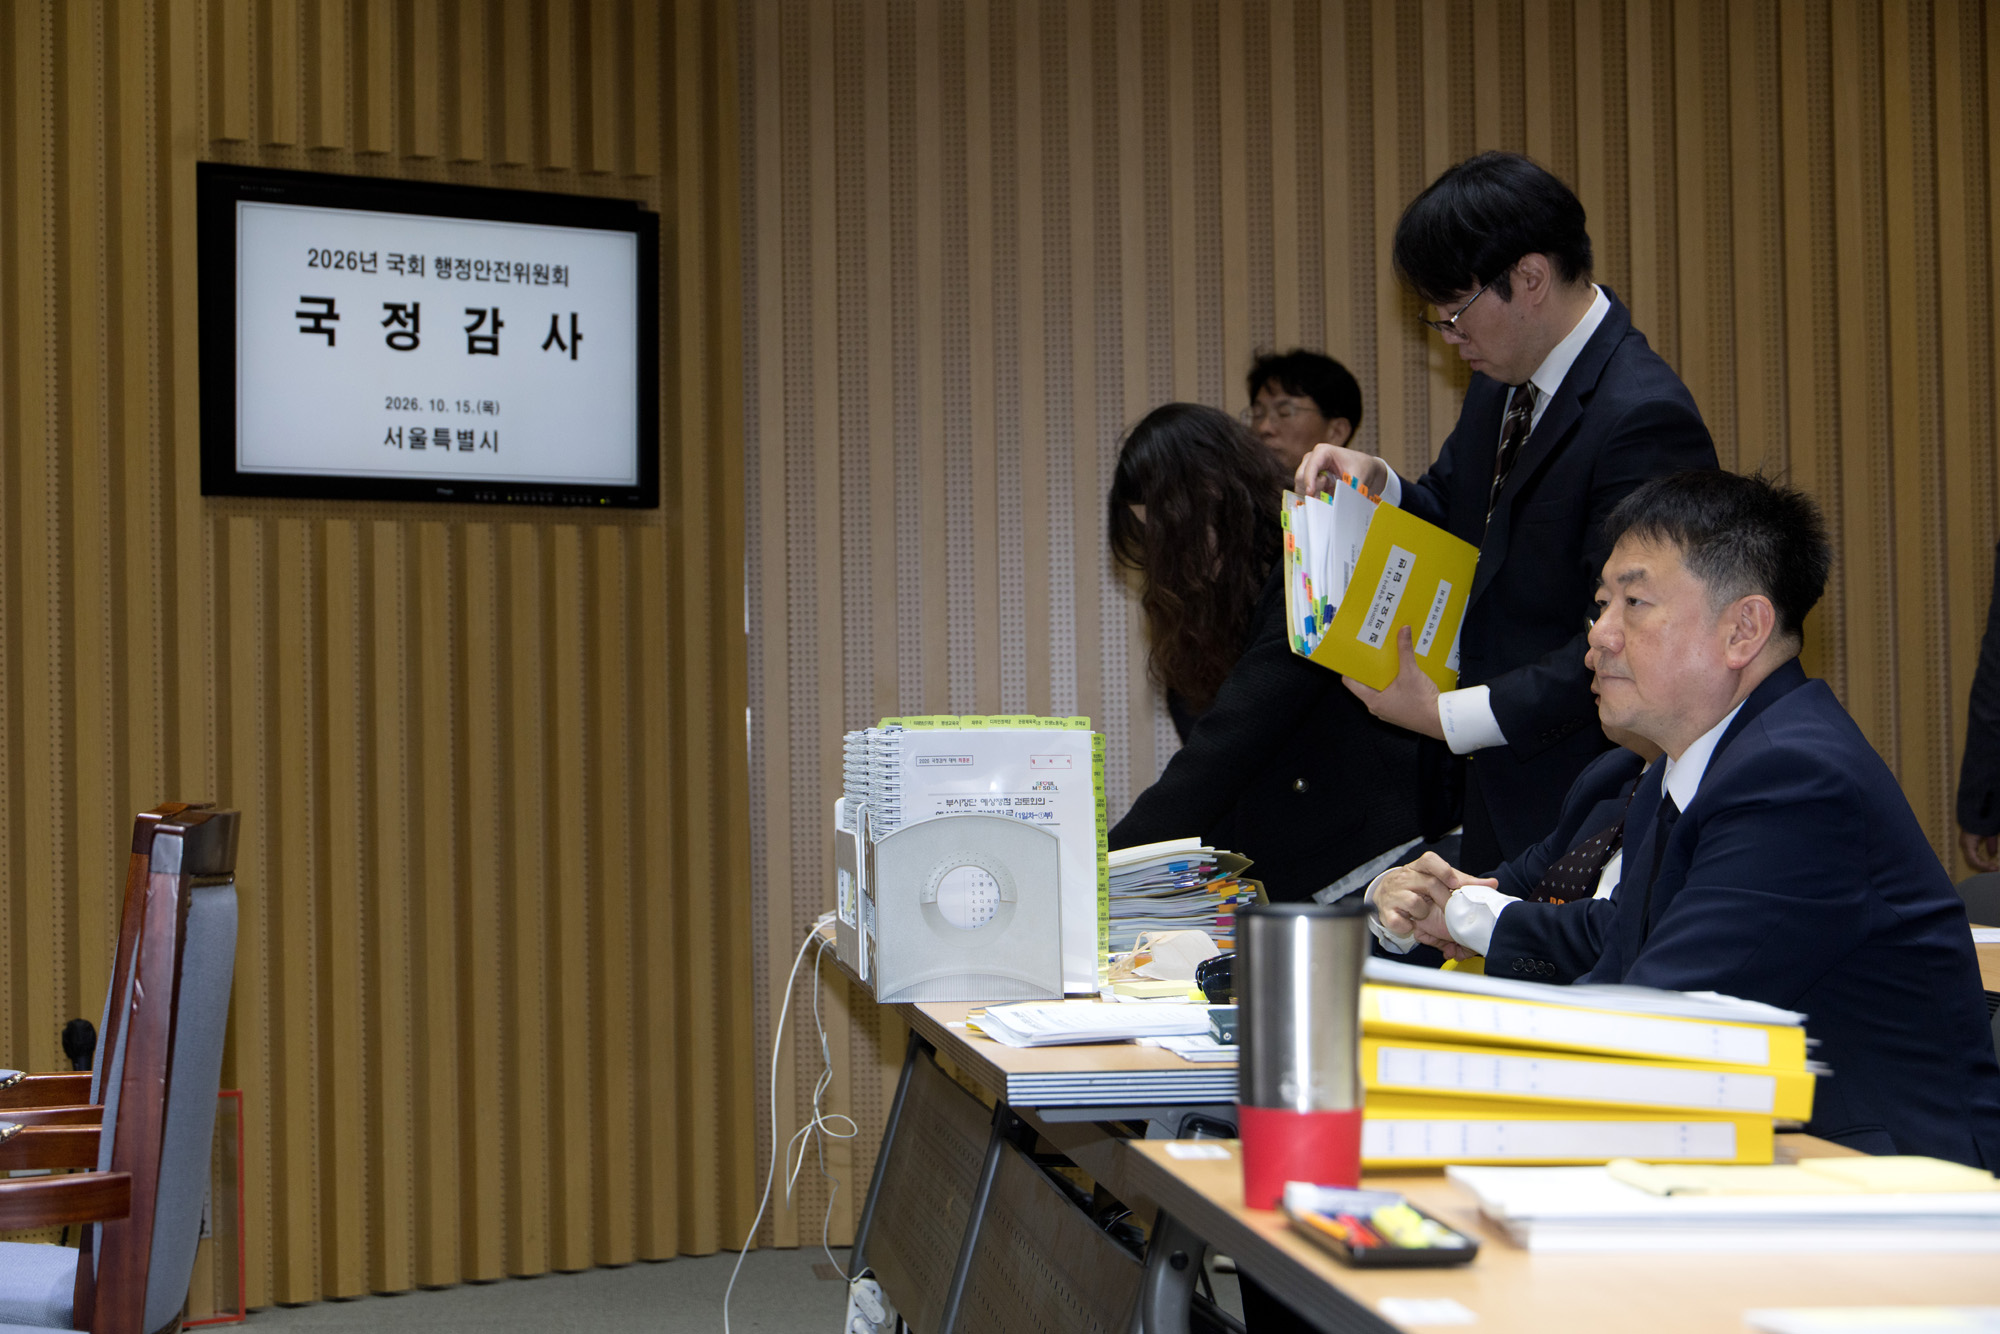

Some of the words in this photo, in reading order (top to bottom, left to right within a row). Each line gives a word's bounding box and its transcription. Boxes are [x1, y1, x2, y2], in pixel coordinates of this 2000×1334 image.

[307, 248, 378, 274] 2026년
[386, 253, 425, 277] 국회
[434, 256, 570, 287] 행정안전위원회
[385, 396, 423, 412] 2026.
[429, 398, 450, 413] 10.
[384, 426, 499, 453] 서울특별시
[945, 798, 977, 808] 부시장단
[1014, 797, 1046, 807] 검토회의
